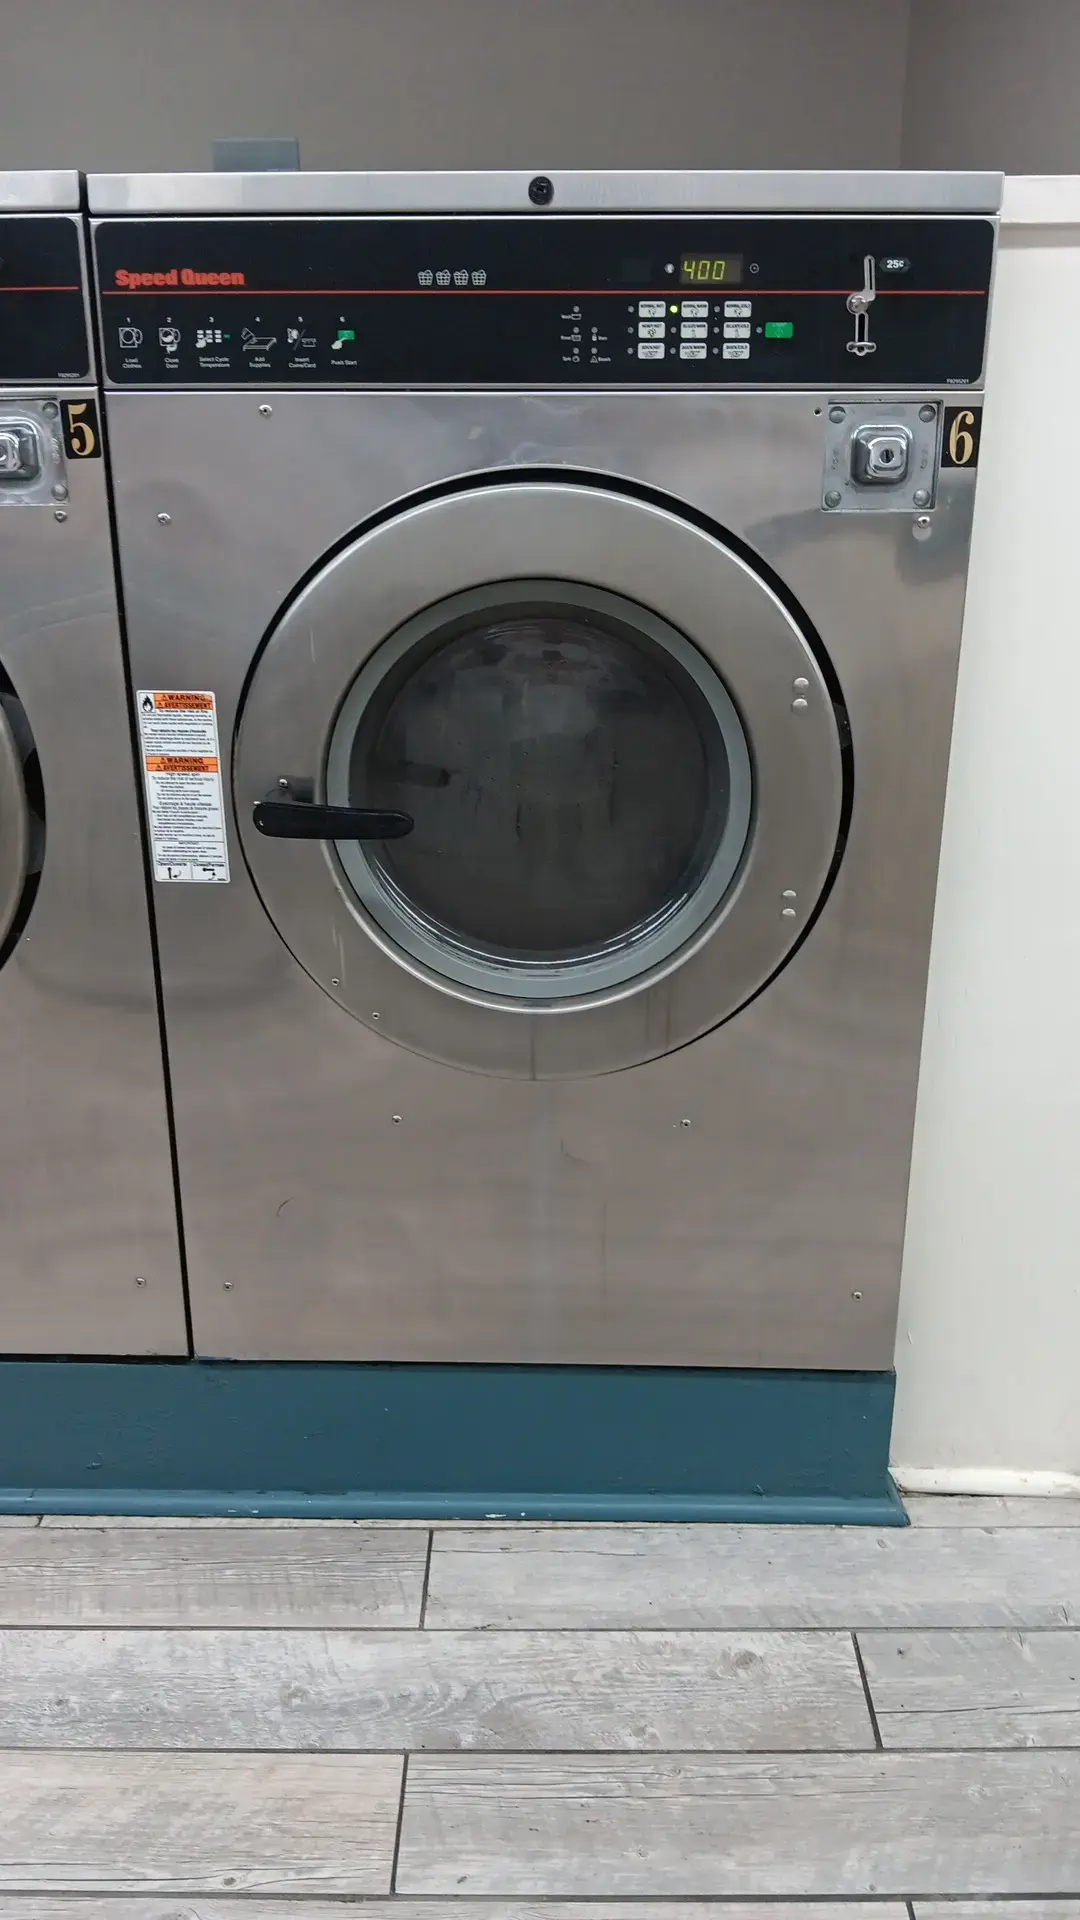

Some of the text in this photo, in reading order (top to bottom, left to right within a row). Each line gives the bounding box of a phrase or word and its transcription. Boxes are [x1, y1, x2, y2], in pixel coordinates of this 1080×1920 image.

[115, 268, 246, 290] Speed Queen
[683, 260, 725, 280] 400
[67, 403, 95, 456] 5
[949, 410, 975, 465] 6
[163, 764, 209, 772] AVERTISSEMENT
[166, 757, 204, 765] WARNING
